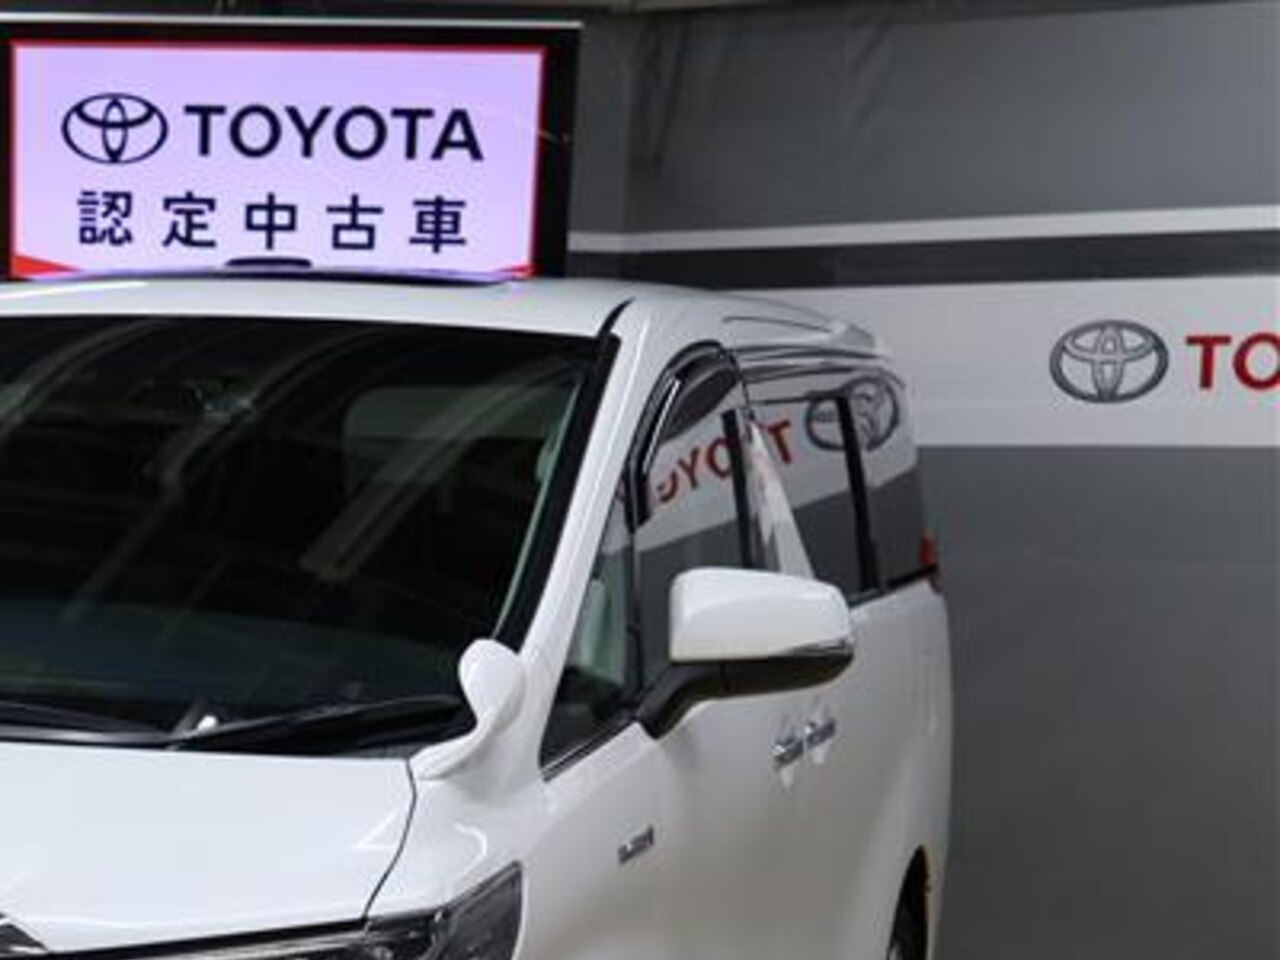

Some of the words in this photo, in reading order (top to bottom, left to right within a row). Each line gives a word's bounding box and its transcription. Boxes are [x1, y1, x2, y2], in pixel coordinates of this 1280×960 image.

[184, 104, 484, 162] TOYOTA
[77, 190, 468, 253] 認定中古車
